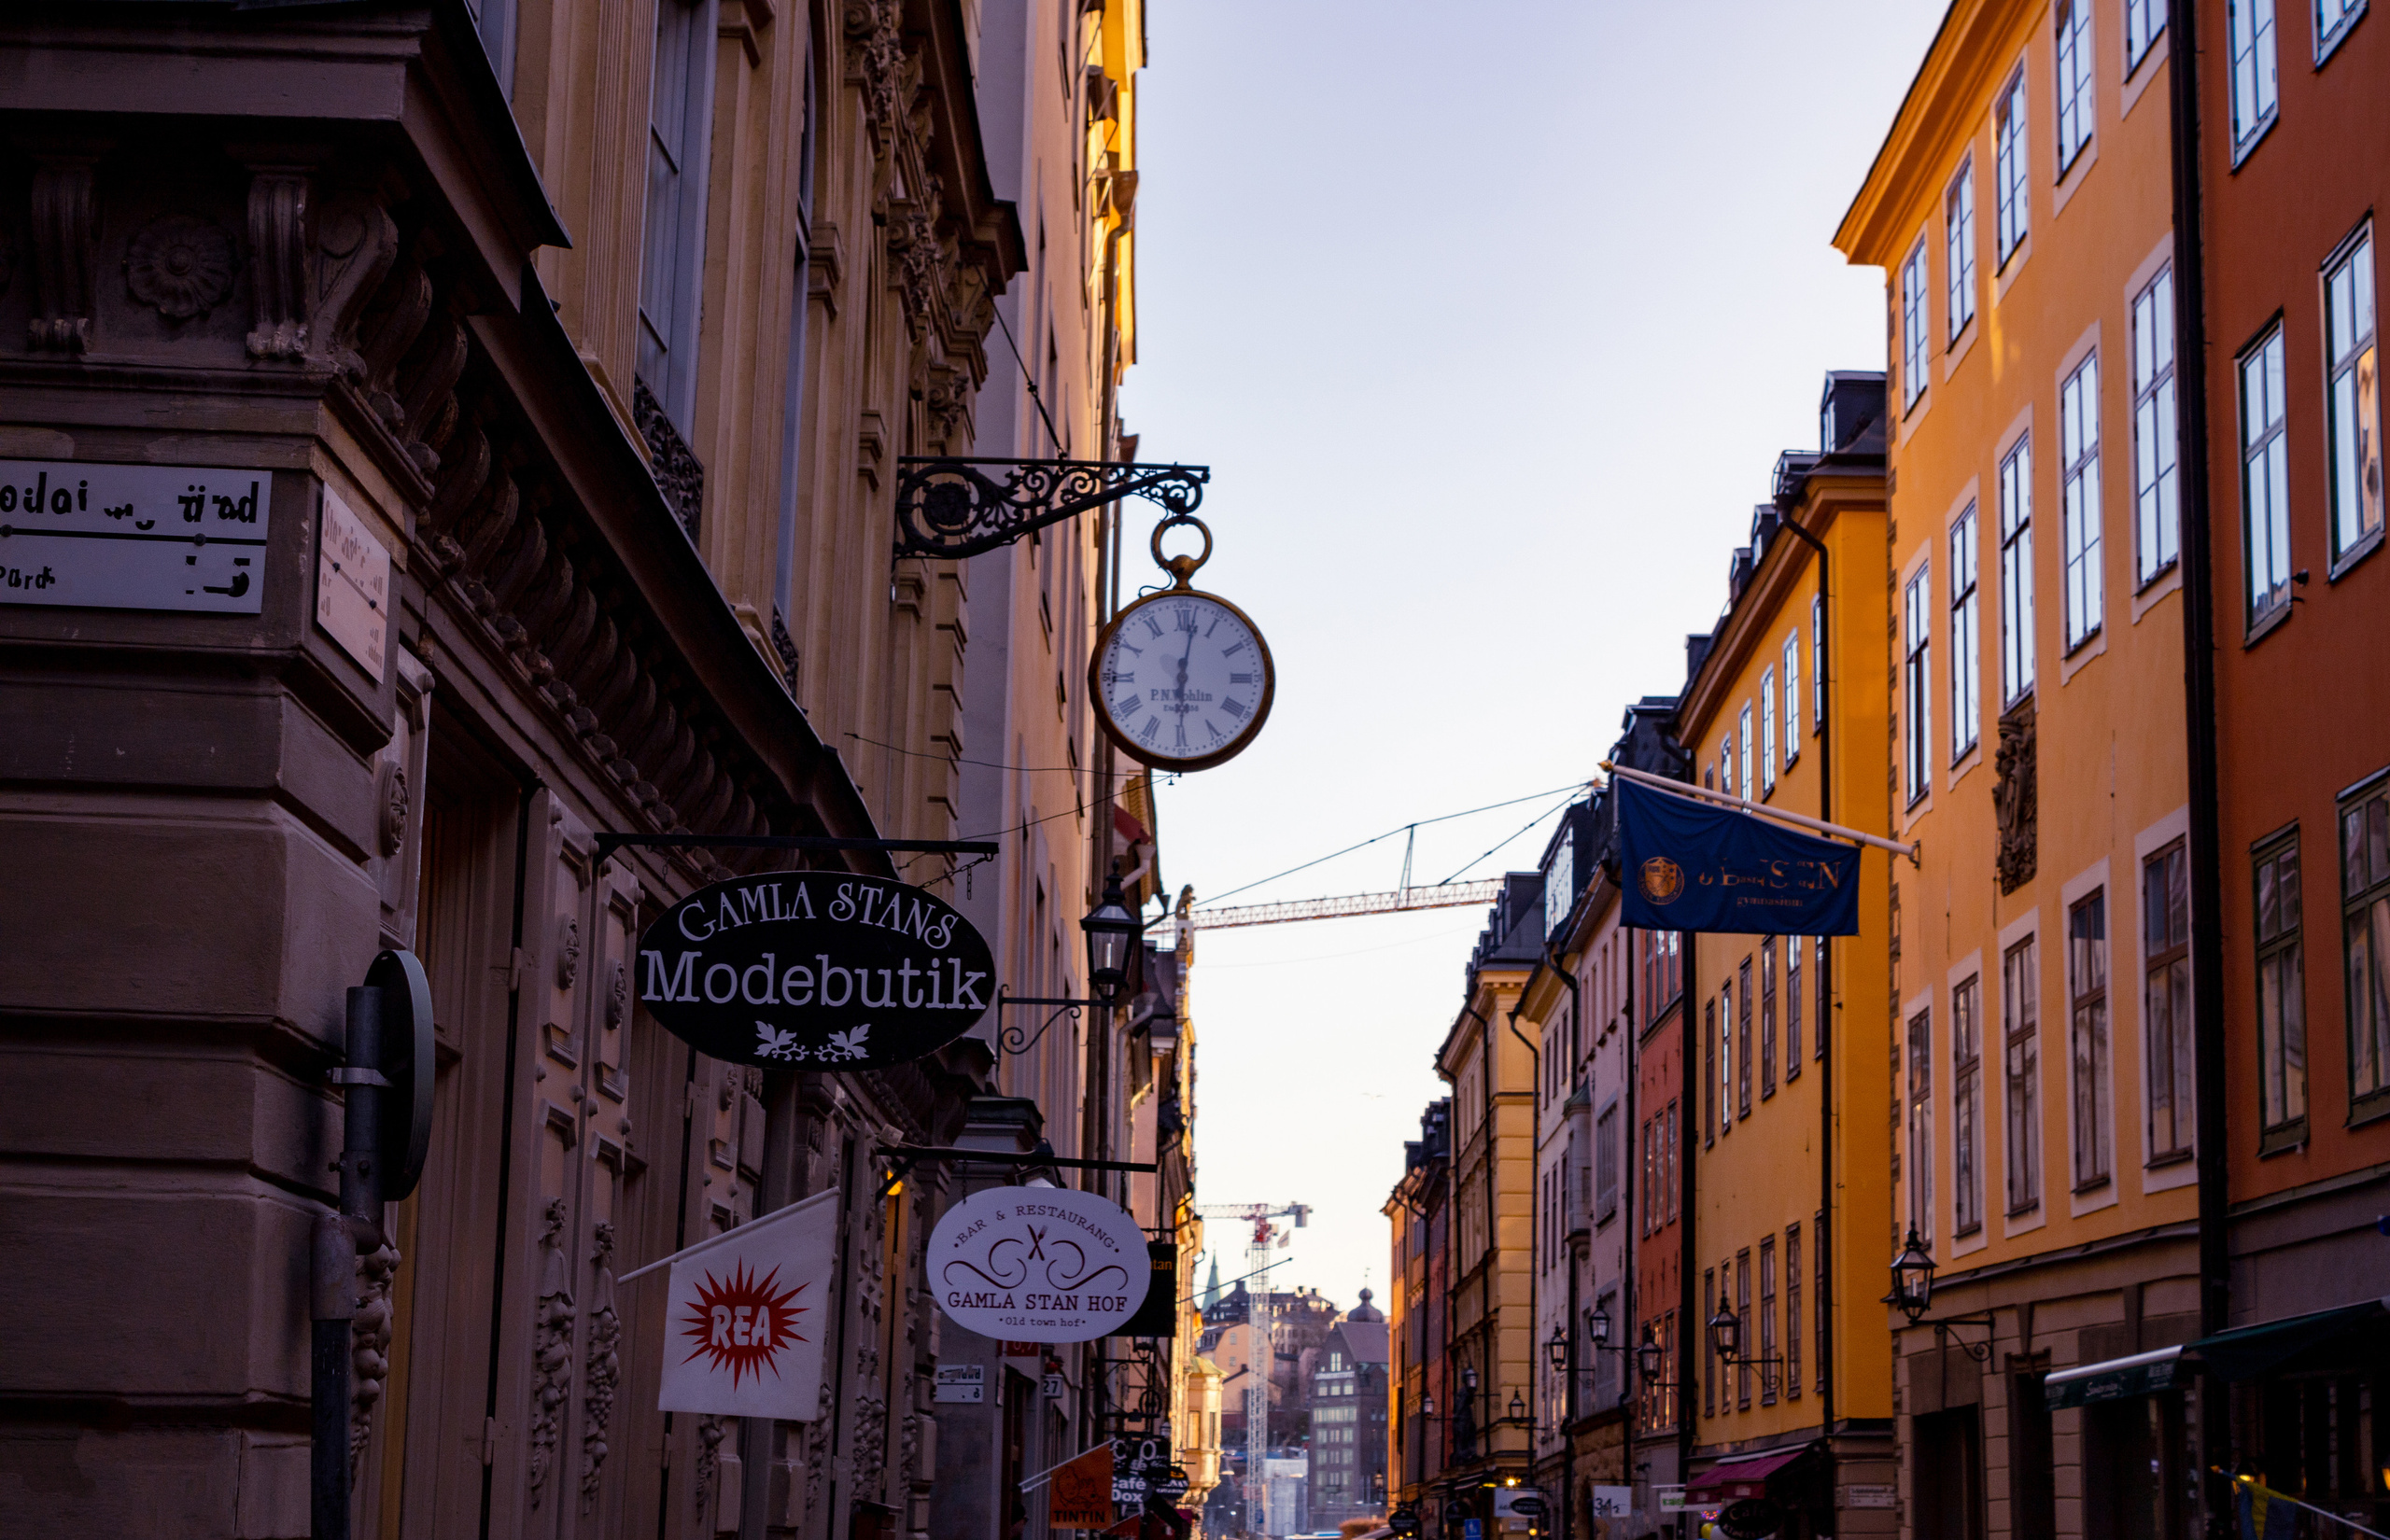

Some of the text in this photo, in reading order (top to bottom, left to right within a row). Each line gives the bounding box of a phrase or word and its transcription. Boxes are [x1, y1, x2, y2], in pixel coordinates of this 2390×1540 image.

[678, 881, 959, 950] GAMLA STANS
[640, 949, 987, 1011] Modebutik
[956, 1219, 987, 1246] BAR
[1016, 1204, 1115, 1249] RESTAURANG
[1150, 1260, 1173, 1270] tan
[948, 1292, 1128, 1312] GAMLA STAN HOF
[710, 1304, 771, 1350] REA
[1030, 1317, 1057, 1326] town
[1061, 1317, 1082, 1327] hof
[1054, 1510, 1105, 1523] TINTIN
